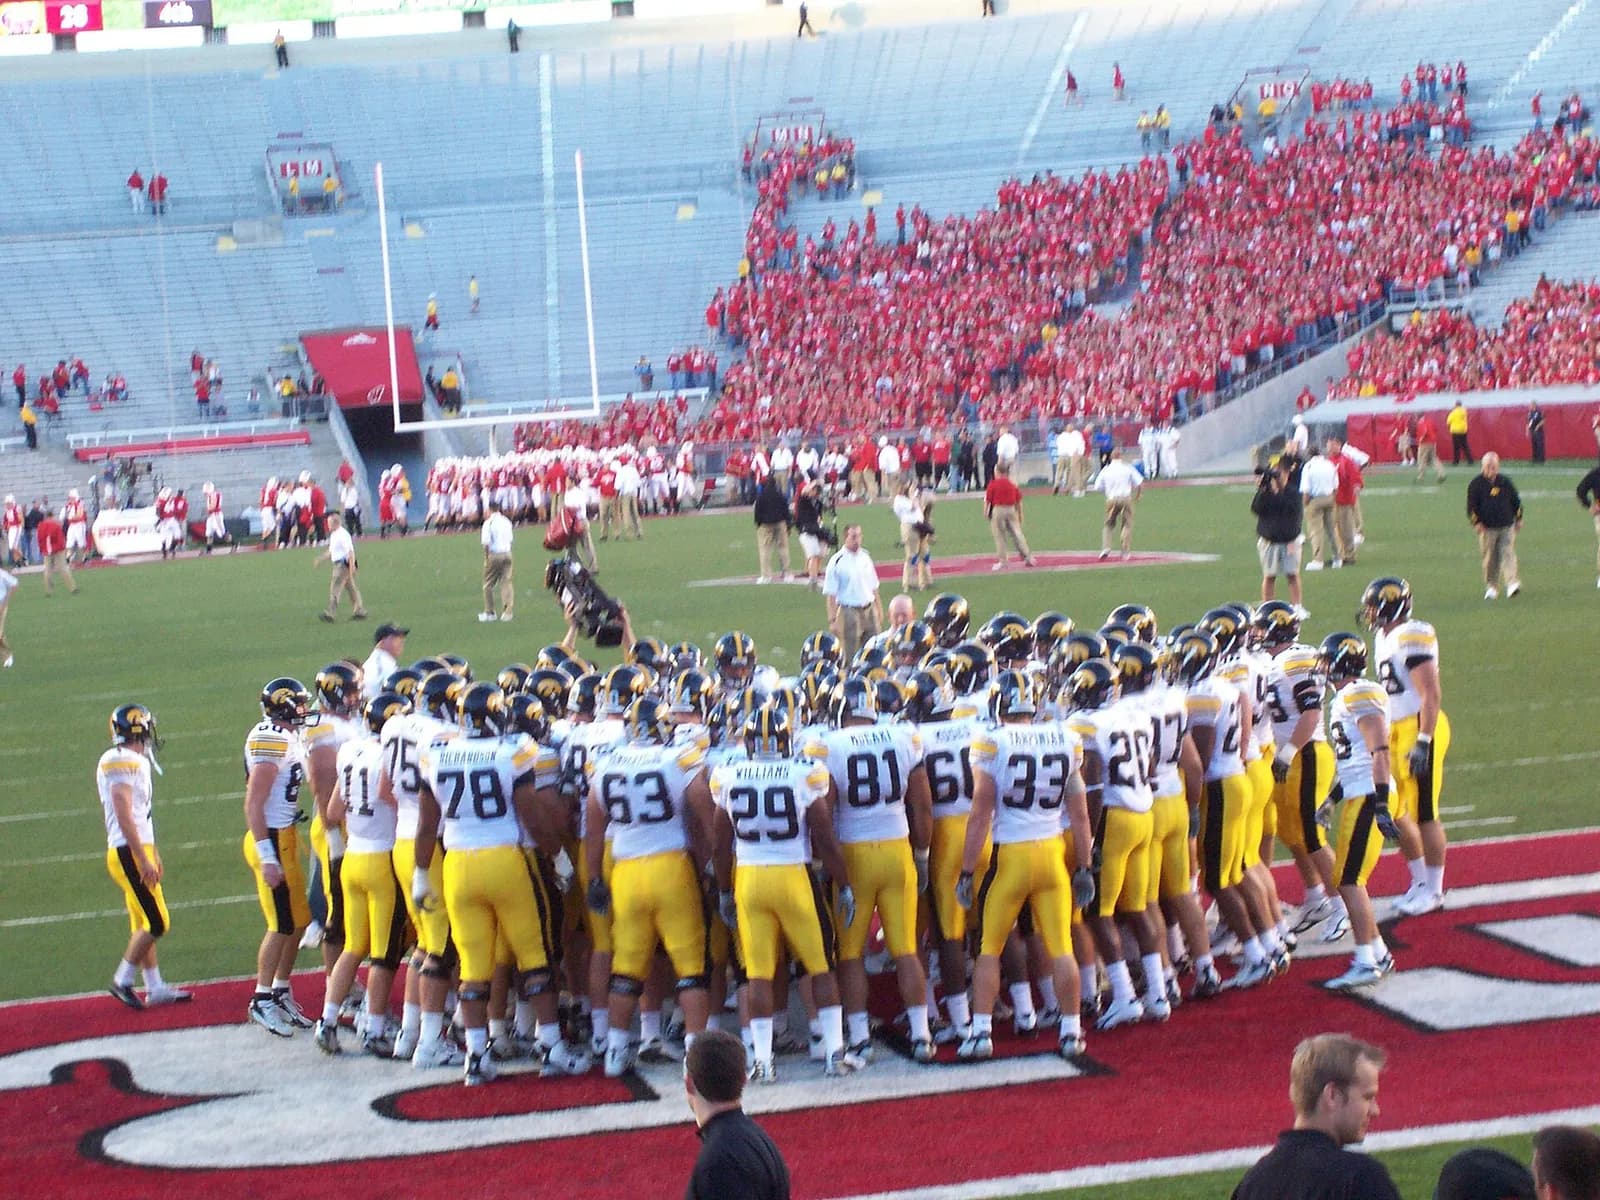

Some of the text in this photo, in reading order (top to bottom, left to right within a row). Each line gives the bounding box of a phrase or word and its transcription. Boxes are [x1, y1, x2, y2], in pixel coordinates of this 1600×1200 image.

[98, 525, 138, 539] ESPN
[343, 762, 374, 817] 11
[437, 769, 507, 820] 78
[602, 770, 674, 824] 63
[736, 764, 792, 780] WILLIAMS
[847, 749, 902, 808] 81
[1002, 753, 1071, 810] 33
[729, 785, 800, 843] 29
